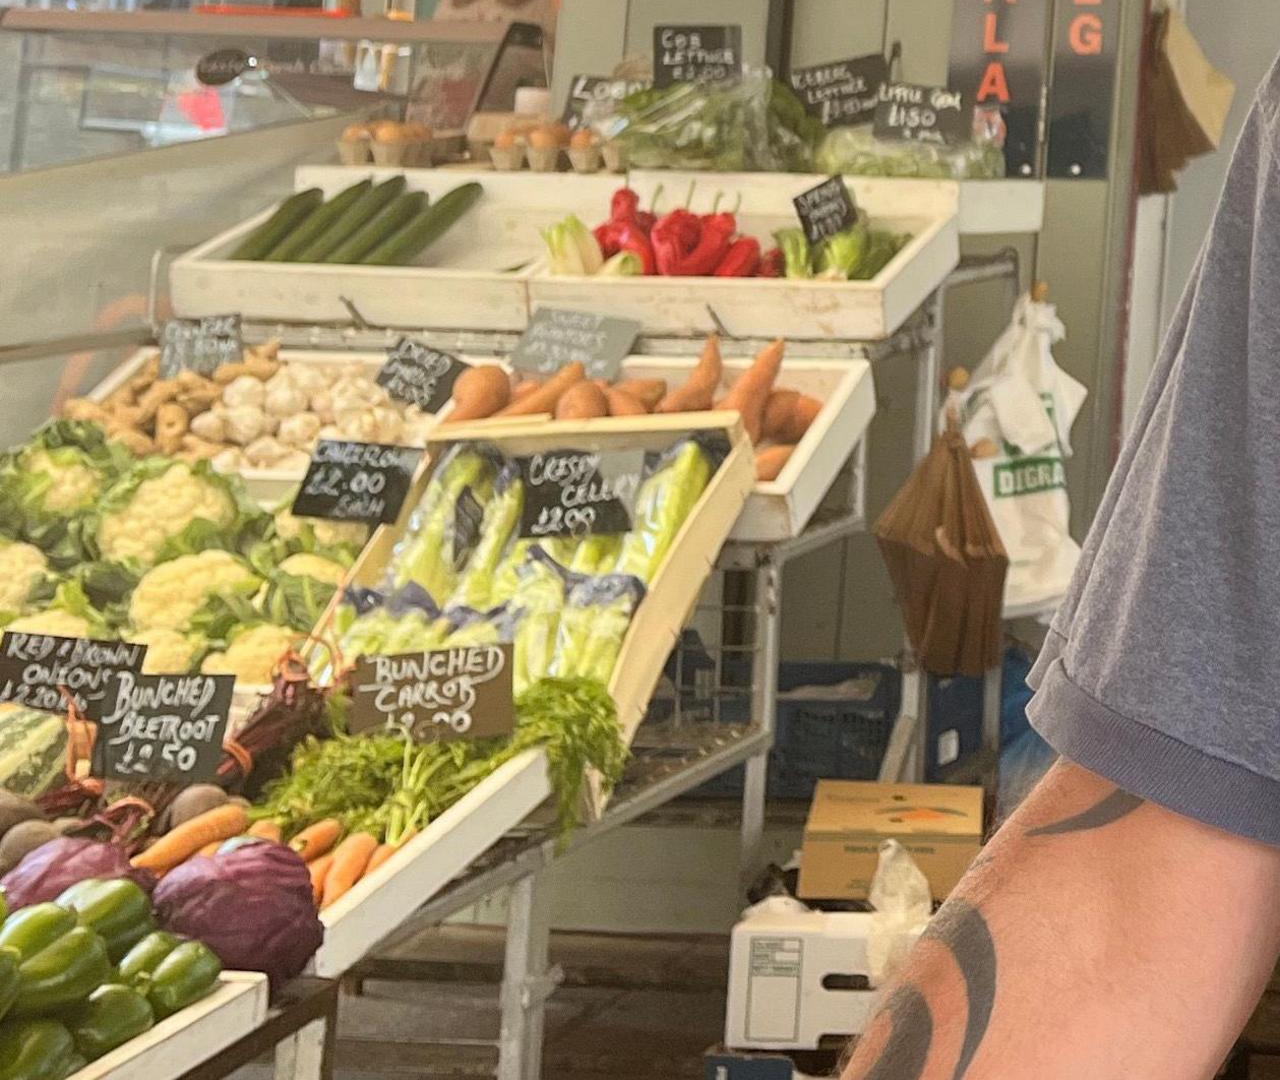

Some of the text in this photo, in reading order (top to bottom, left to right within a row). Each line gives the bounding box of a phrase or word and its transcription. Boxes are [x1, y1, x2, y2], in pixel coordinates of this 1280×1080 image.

[350, 647, 505, 692] BUNCHED
[101, 671, 216, 724] BUNCHED
[108, 712, 220, 747] BEETROOT
